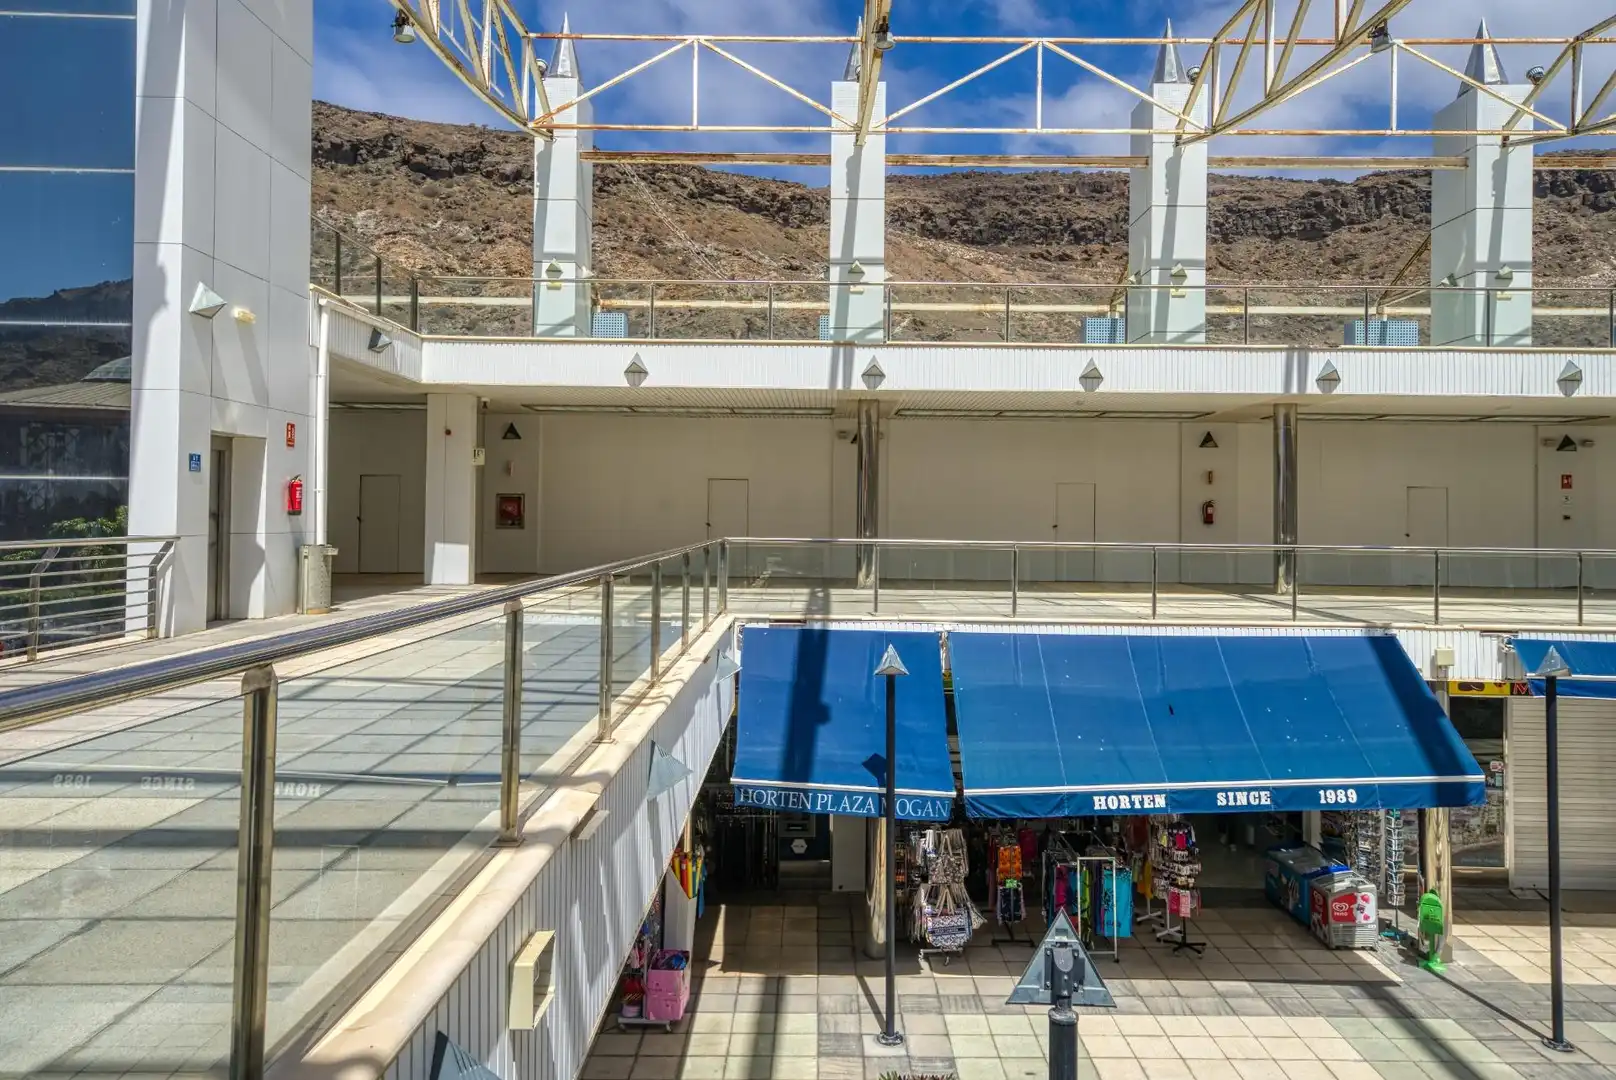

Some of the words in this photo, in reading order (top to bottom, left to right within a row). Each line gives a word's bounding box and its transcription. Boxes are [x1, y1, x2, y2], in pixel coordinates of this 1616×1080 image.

[738, 788, 812, 810] HORTEN
[816, 793, 876, 814] PLAZA
[1093, 793, 1167, 811] HORTEN
[1216, 791, 1272, 806] SINCE
[1318, 788, 1358, 804] 1989
